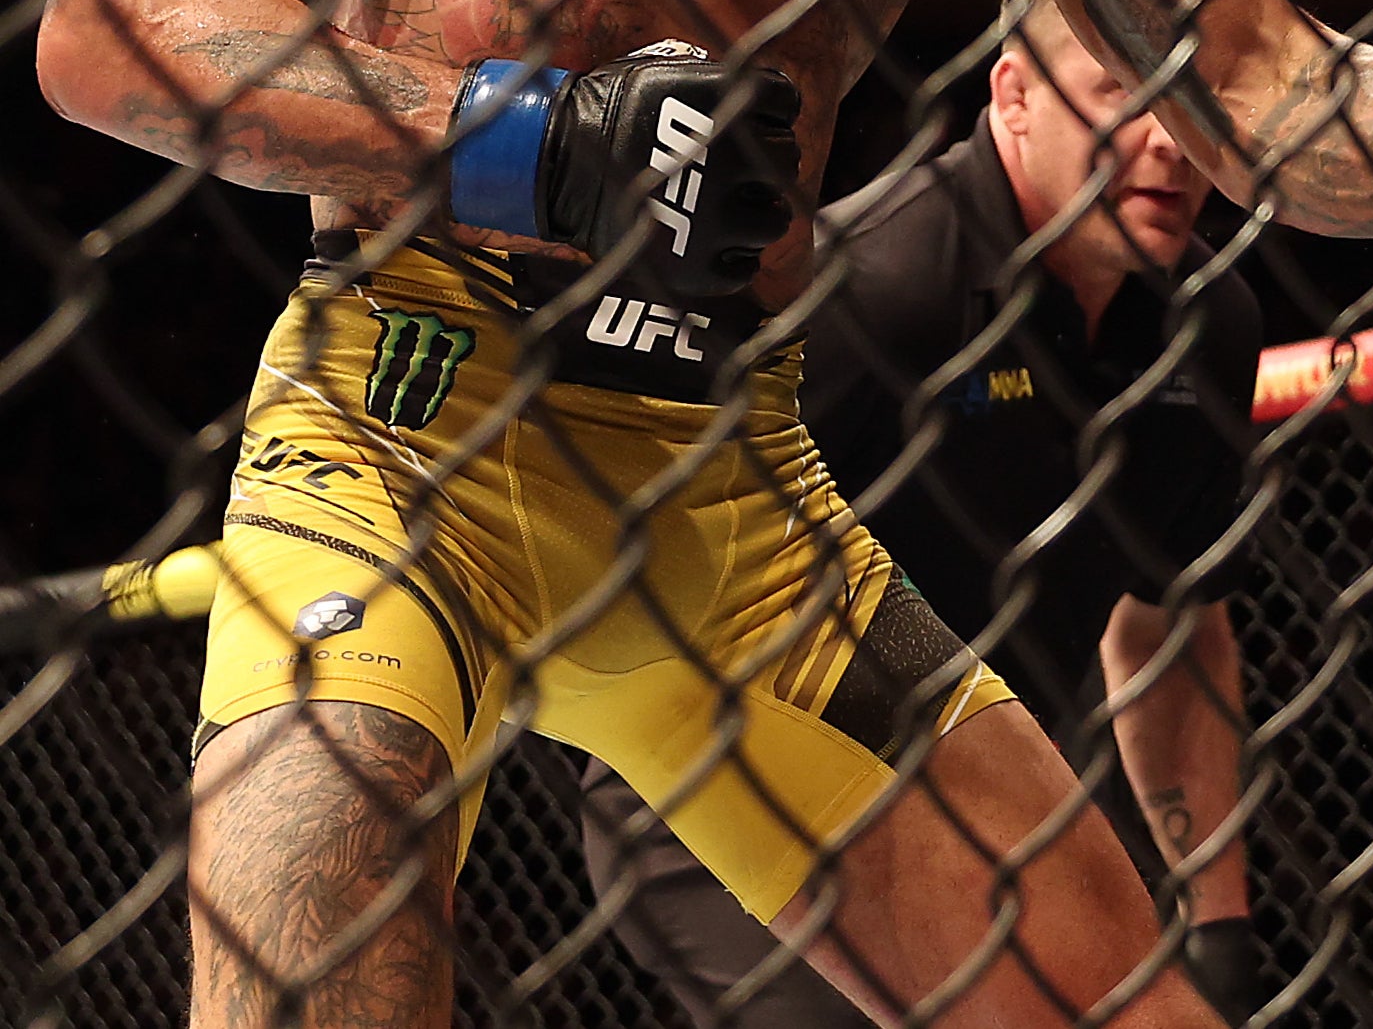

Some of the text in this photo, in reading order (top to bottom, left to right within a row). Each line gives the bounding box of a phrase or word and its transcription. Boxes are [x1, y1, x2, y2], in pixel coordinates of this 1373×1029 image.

[648, 96, 715, 258] UFC
[586, 295, 712, 362] UFC
[250, 436, 364, 491] UFC
